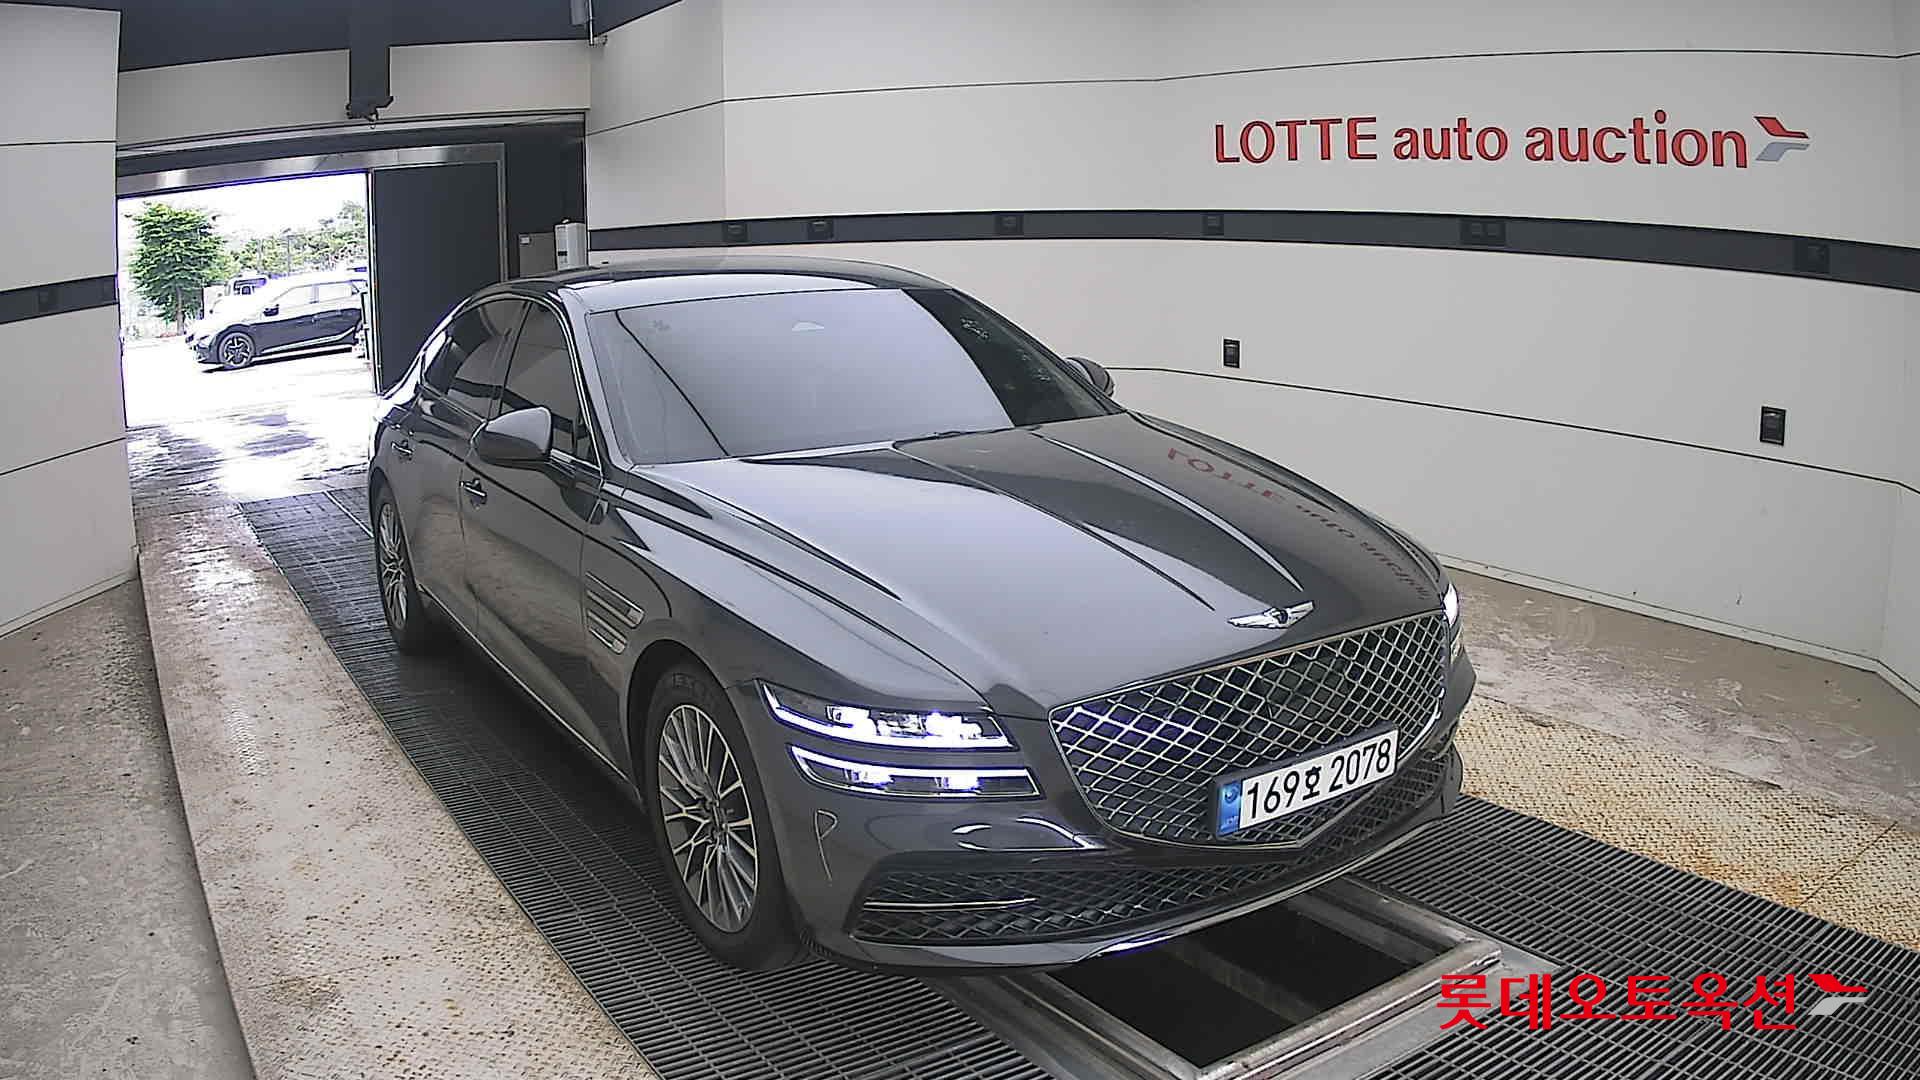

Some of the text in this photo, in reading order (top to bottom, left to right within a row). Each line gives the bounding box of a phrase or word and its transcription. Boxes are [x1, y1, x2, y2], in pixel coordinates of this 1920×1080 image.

[1215, 109, 1748, 169] LOTTE auto auction
[1247, 738, 1392, 819] 169호 2078
